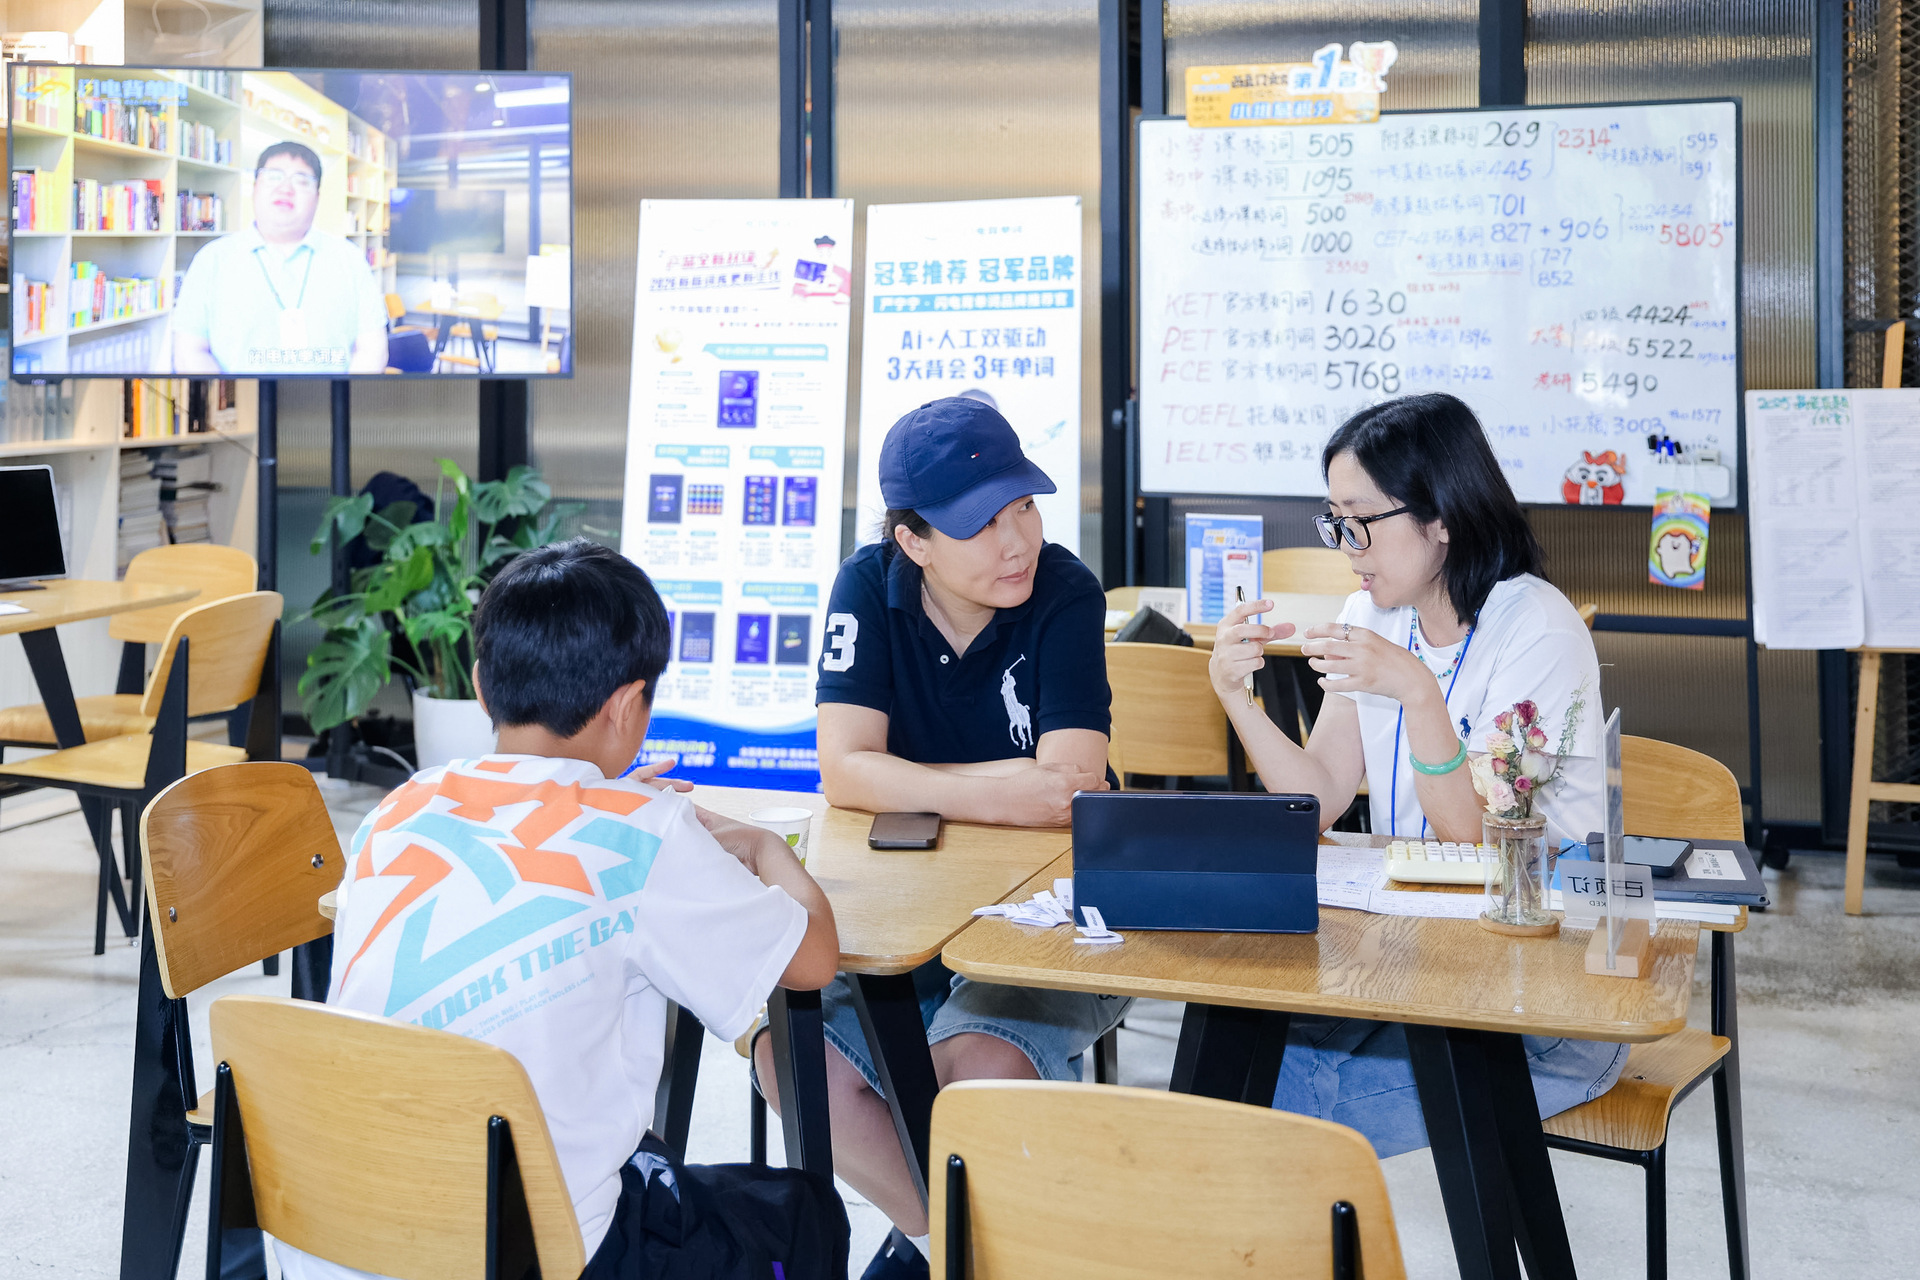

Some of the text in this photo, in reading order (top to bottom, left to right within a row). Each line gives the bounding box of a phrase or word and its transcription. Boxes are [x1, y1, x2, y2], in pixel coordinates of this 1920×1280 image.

[1307, 133, 1353, 157] 505
[1484, 121, 1540, 148] 269
[1558, 128, 1611, 148] 2314
[1686, 132, 1718, 150] 595
[1302, 166, 1353, 197] 1095
[1488, 159, 1532, 181] 445
[1305, 203, 1346, 225] 500
[1488, 194, 1525, 216] 701
[1301, 231, 1352, 253] 1000
[1490, 222, 1531, 243] 827
[1559, 217, 1609, 242] 906
[1659, 223, 1724, 248] 5803
[875, 255, 1074, 286] 冠军推荐 冠军品牌
[1538, 271, 1575, 287] 852
[1165, 292, 1220, 318] KET
[1325, 289, 1407, 316] 1630
[1626, 304, 1693, 326] 4424
[1162, 326, 1218, 354] PET
[1324, 325, 1396, 351] 3026
[1458, 328, 1493, 347] 1396
[1626, 337, 1694, 359] 5522
[887, 355, 1054, 380] 3天背会3年单词
[1161, 361, 1213, 383] FCE
[1324, 361, 1400, 394] 5768
[1534, 372, 1658, 398] 考研 5490
[1162, 403, 1243, 427] TOEFL
[1613, 417, 1667, 437] 3003
[1165, 441, 1249, 464] IELTS
[823, 613, 858, 672] 3
[510, 927, 585, 981] THE
[590, 906, 639, 947] GA
[501, 1005, 514, 1016] BIG
[519, 994, 536, 1007] PLAY
[524, 999, 547, 1014] REACH
[548, 983, 577, 1002] ENDLESS
